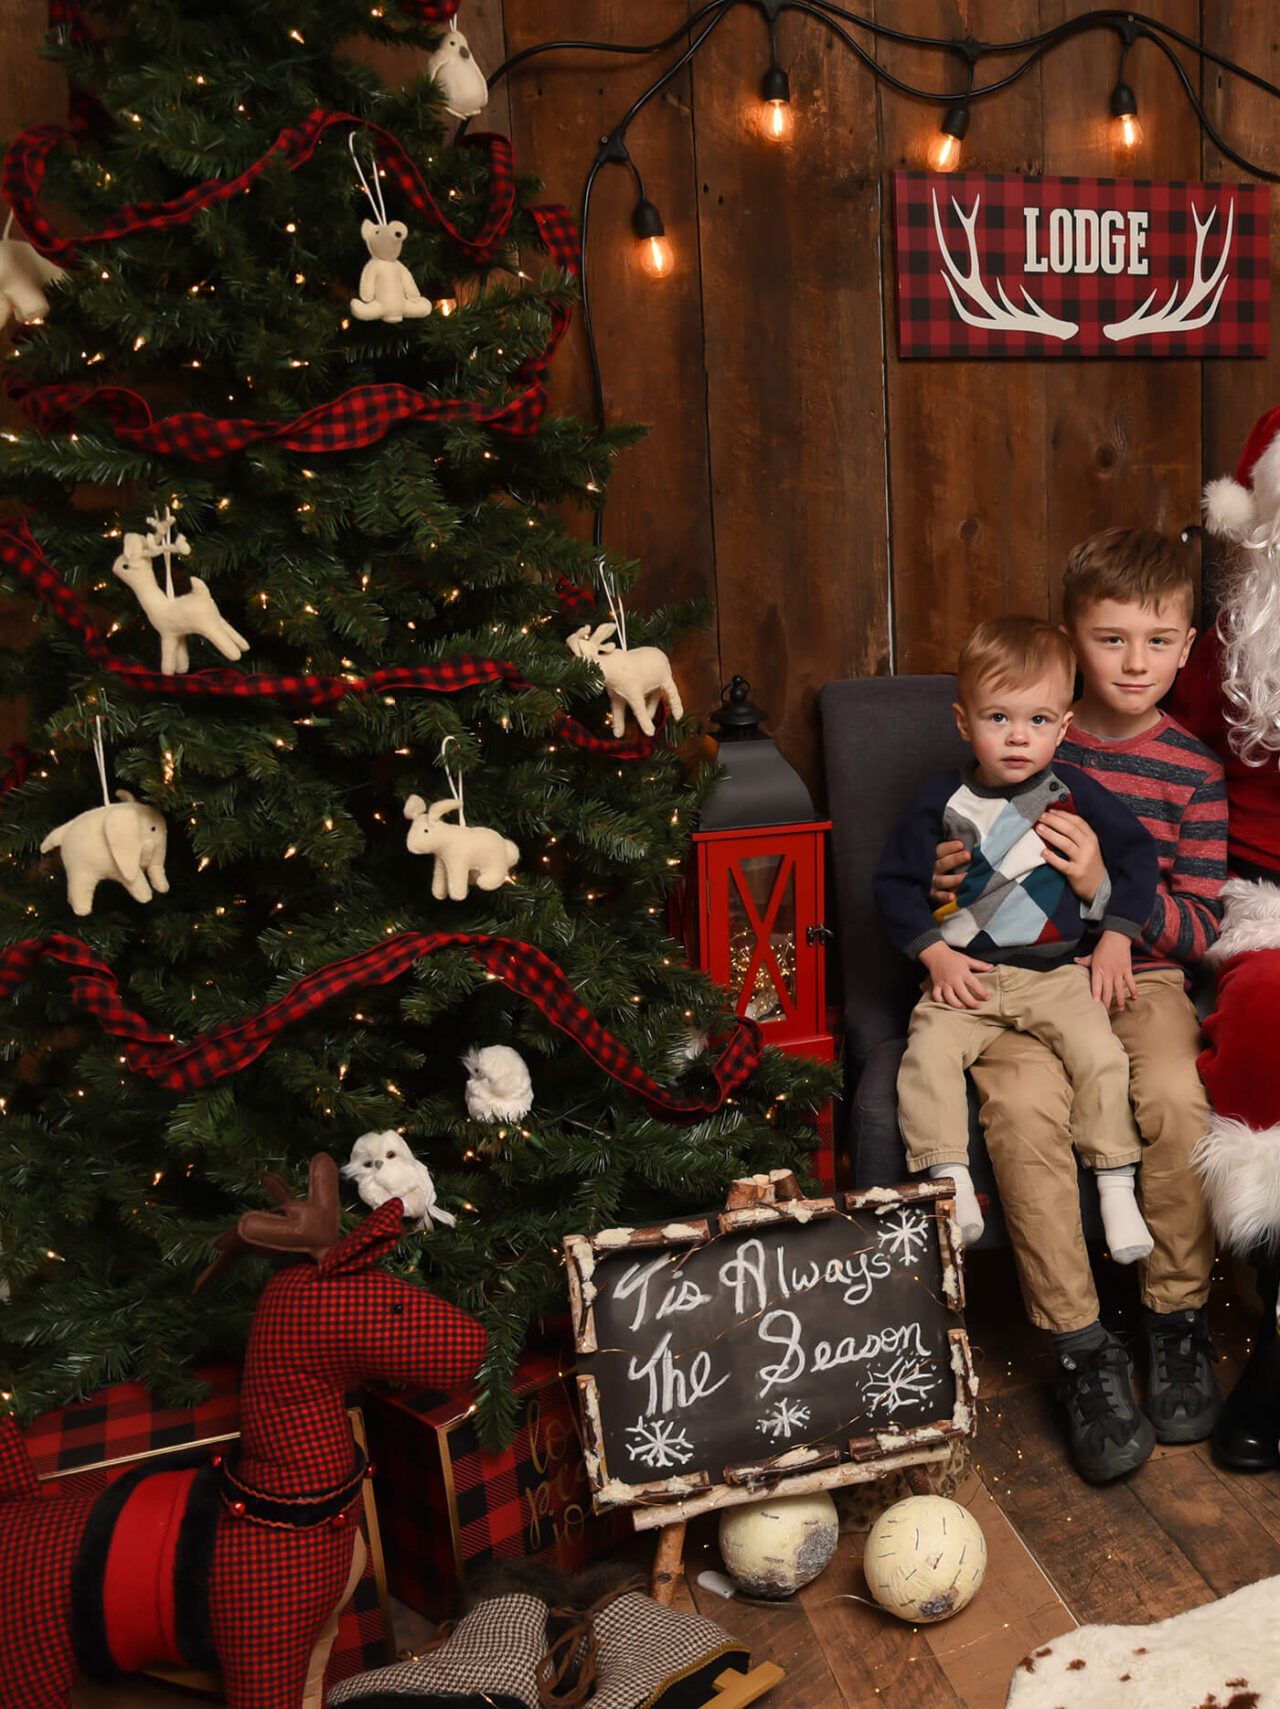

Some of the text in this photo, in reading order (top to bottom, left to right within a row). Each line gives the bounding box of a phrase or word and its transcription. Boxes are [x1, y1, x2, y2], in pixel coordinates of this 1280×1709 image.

[1023, 207, 1149, 275] LODGE
[719, 1238, 892, 1315] Always
[628, 1309, 932, 1417] The Season
